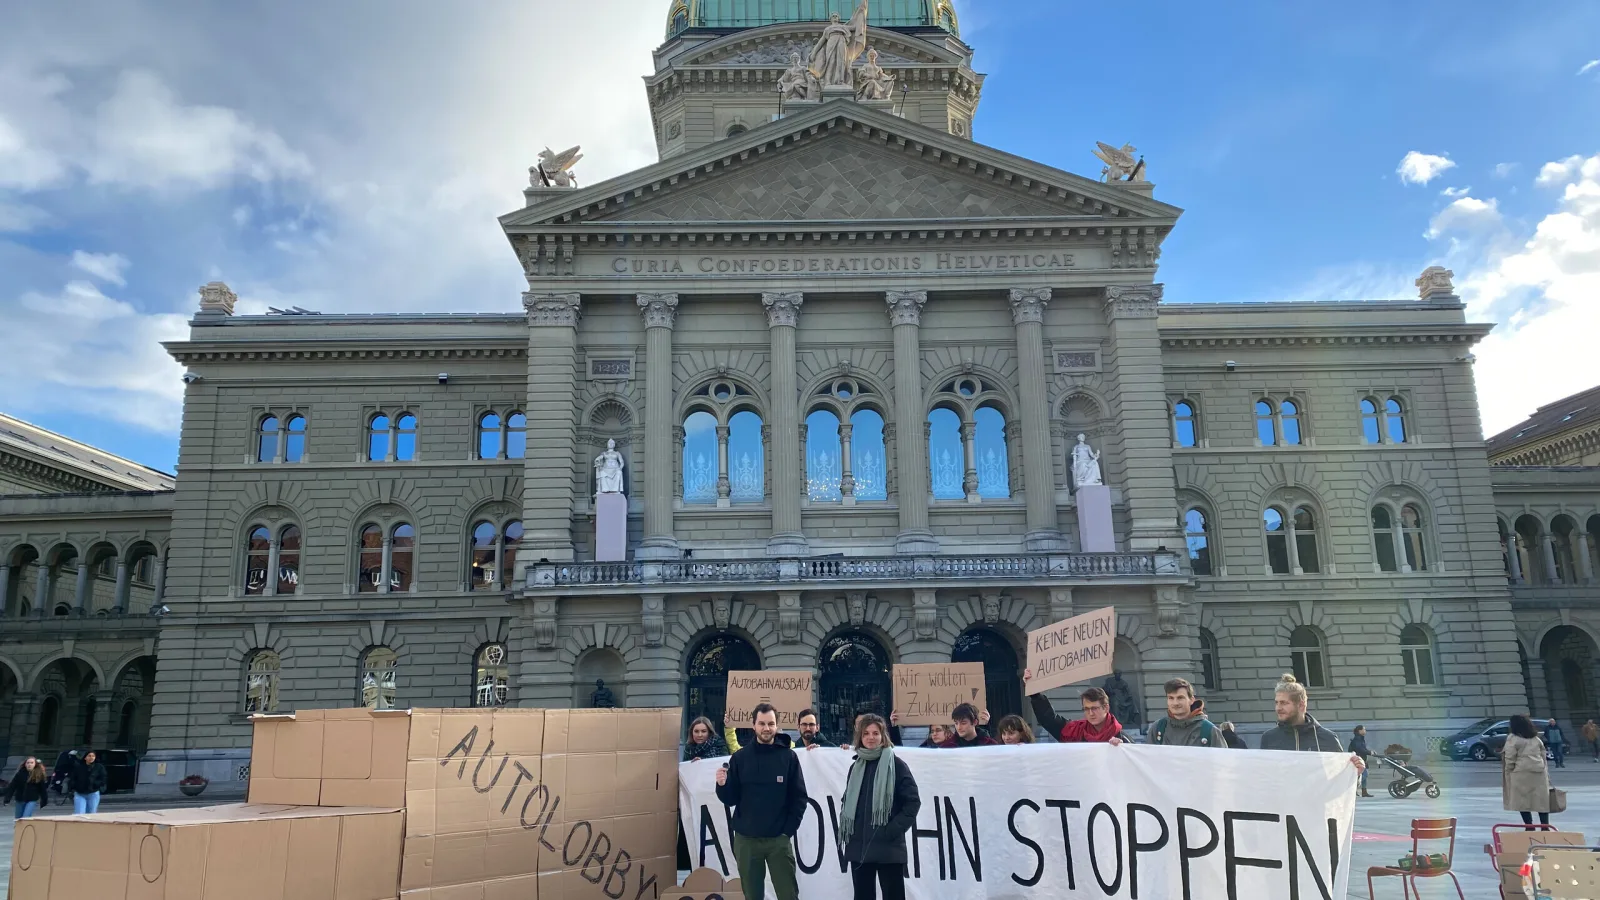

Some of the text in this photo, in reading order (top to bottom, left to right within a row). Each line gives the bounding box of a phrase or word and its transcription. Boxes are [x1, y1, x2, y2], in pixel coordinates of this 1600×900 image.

[611, 253, 1075, 273] CURIA CONFOEDERATIONIS HELVETICAE
[1035, 615, 1111, 654] KEINE NEUEN
[1036, 640, 1108, 678] AUTOBAHNEN
[730, 676, 810, 691] AUTOBAHNAUSBAU
[898, 667, 967, 688] Wir wollen
[439, 724, 659, 900] AUTOLOBBY
